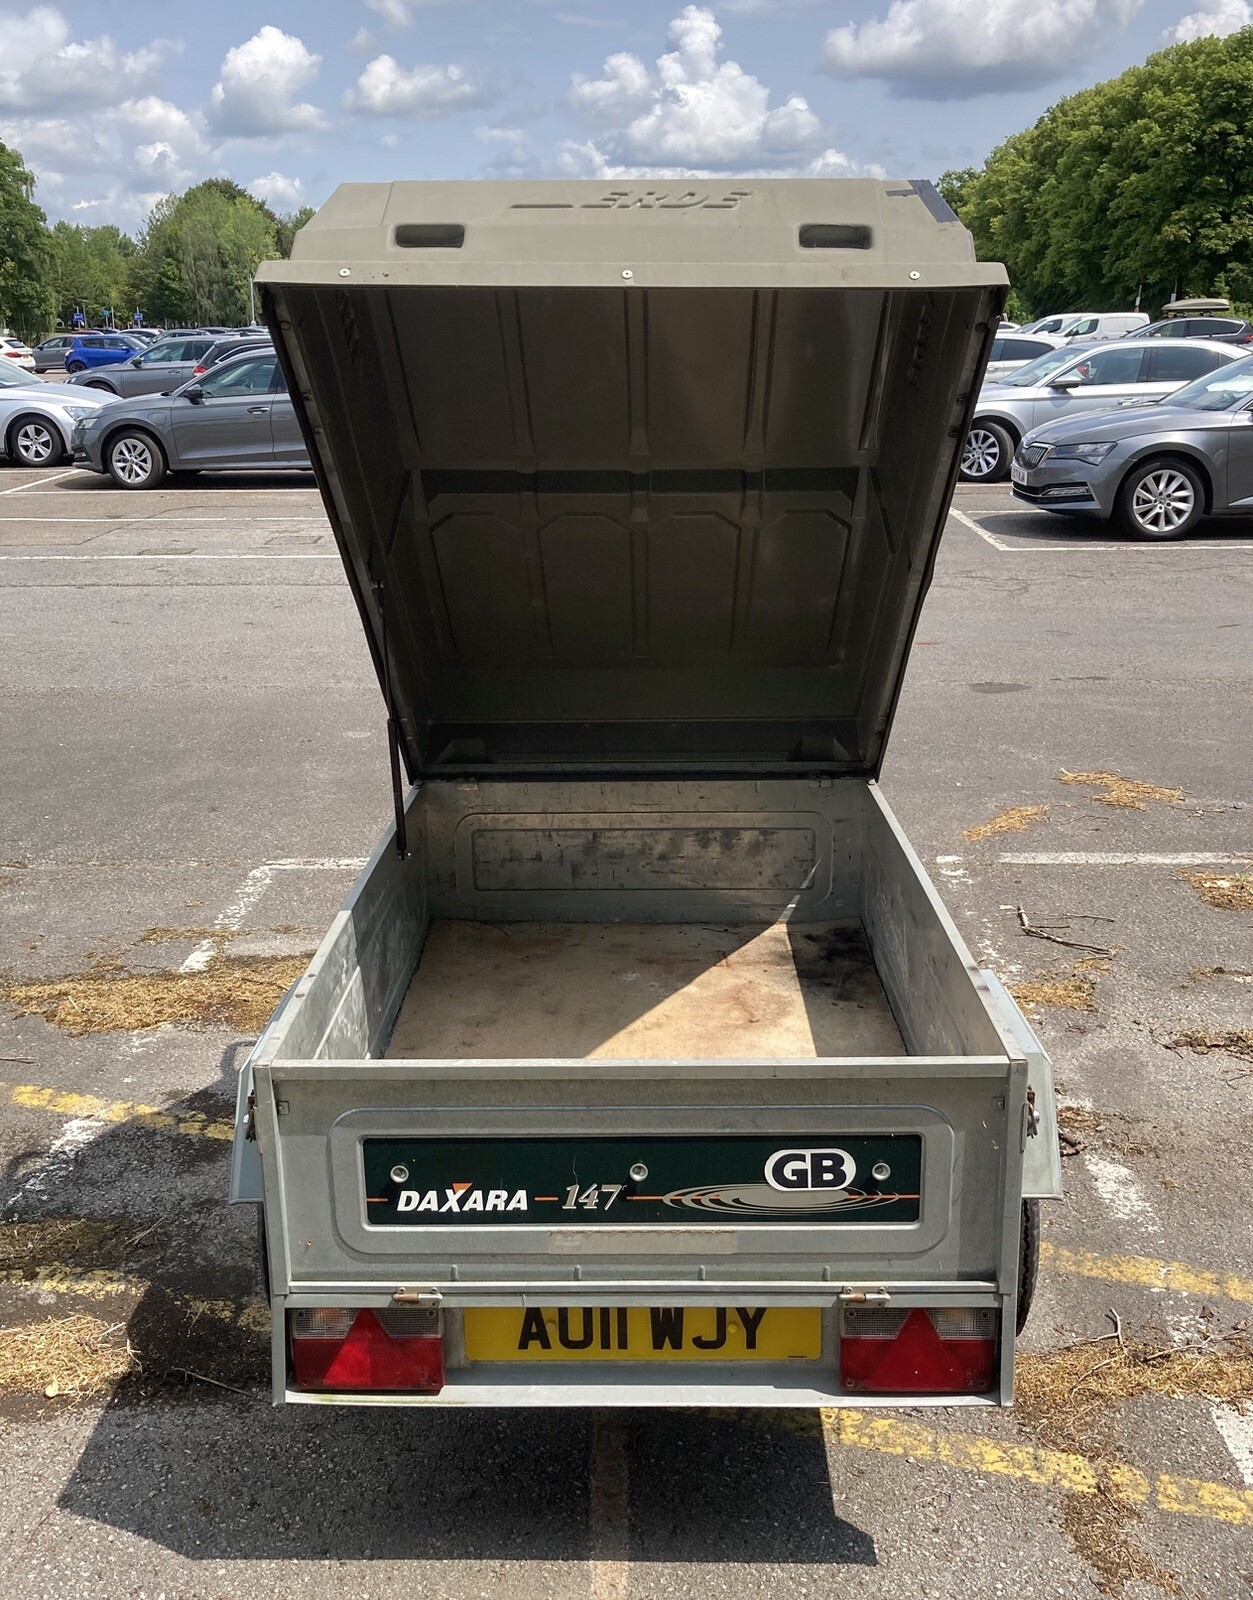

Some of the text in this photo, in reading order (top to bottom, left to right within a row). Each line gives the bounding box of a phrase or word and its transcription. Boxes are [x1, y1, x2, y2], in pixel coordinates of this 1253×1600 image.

[582, 188, 752, 209] ERDE
[771, 1152, 847, 1189] GB
[396, 1183, 622, 1213] DAXARA 147
[517, 1307, 768, 1350] AU11 WJY
